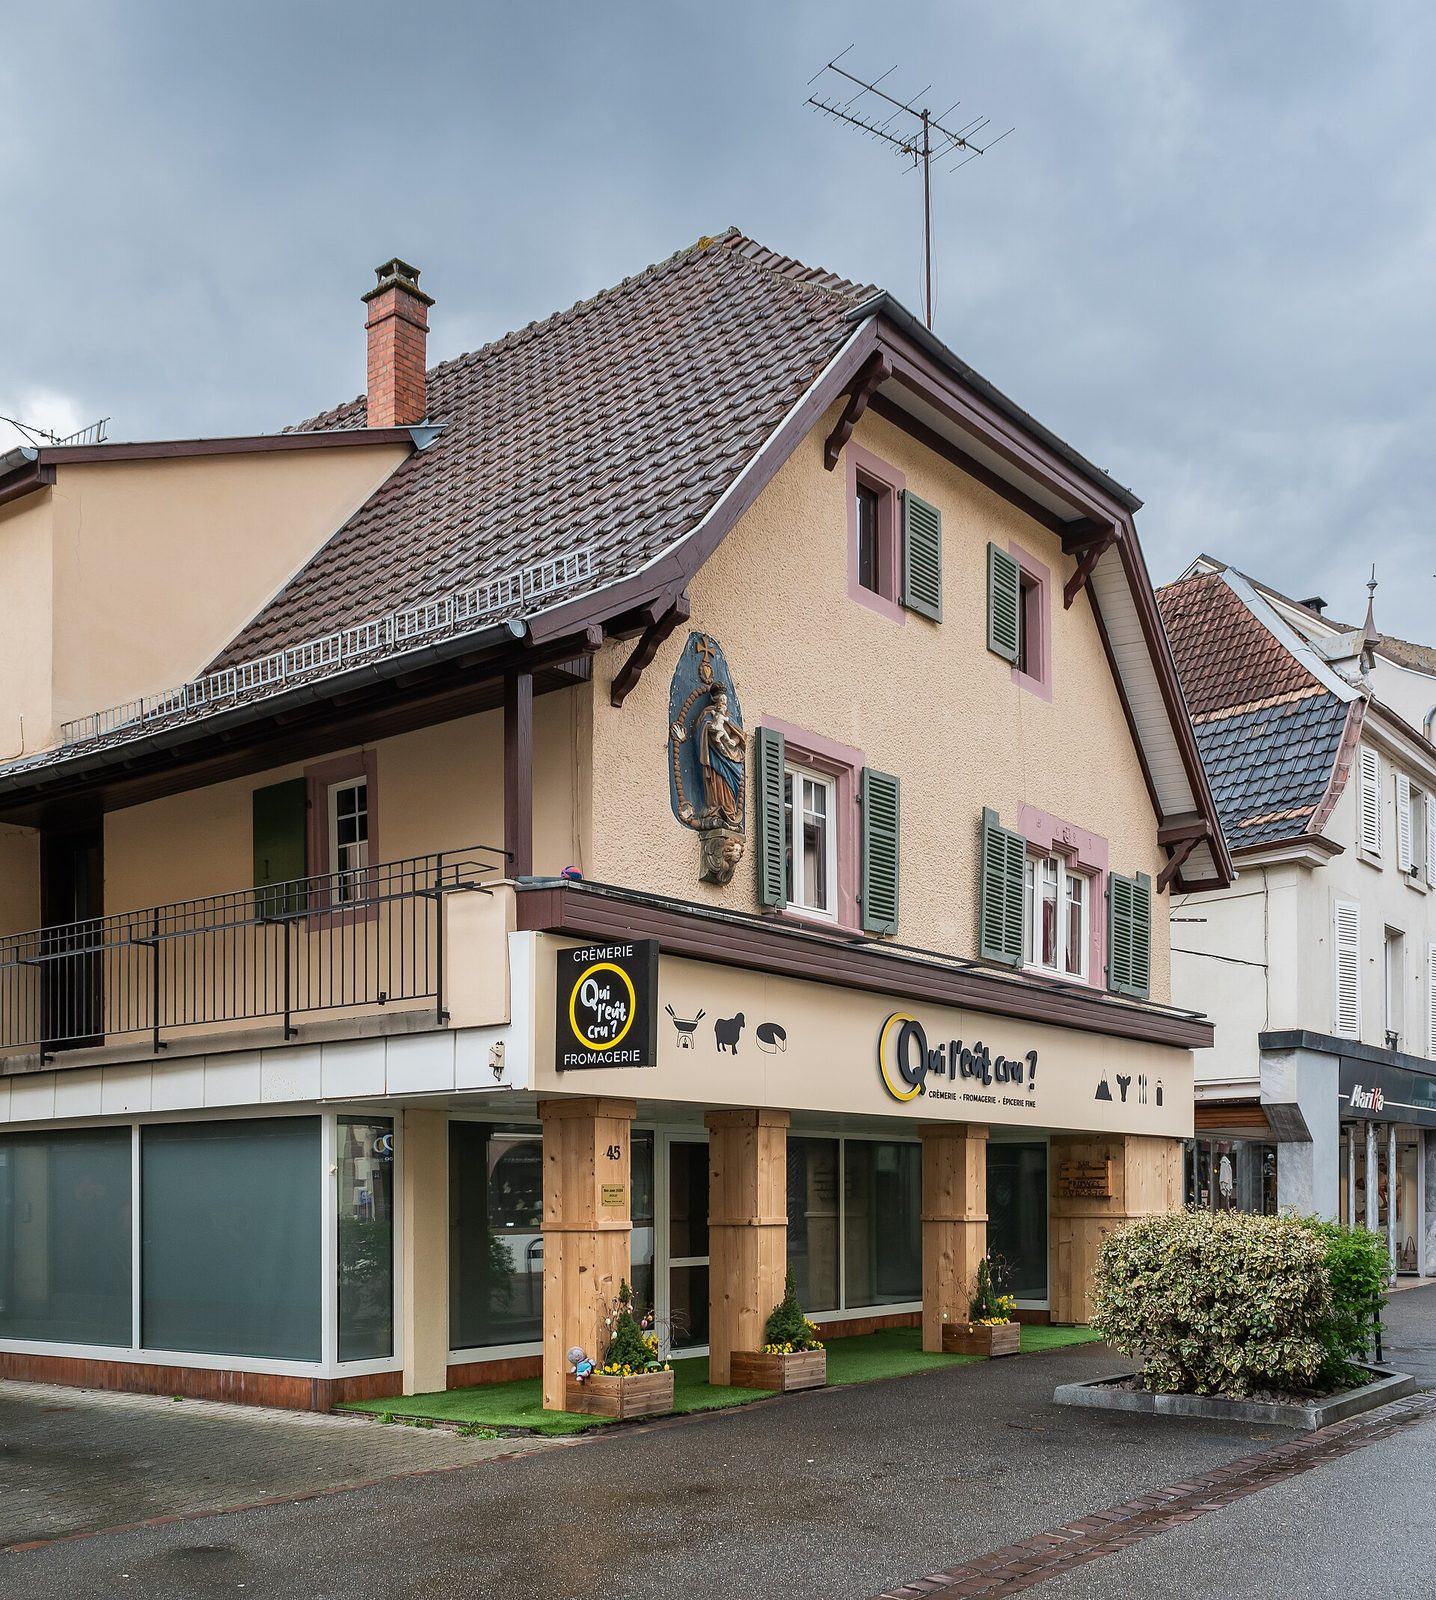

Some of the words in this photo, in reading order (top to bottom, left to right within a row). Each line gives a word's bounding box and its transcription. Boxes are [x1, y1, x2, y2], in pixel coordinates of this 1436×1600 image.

[573, 945, 633, 962] CRÈMERIE
[581, 979, 610, 1011] Qui
[597, 1001, 627, 1022] l'eût
[564, 1050, 641, 1065] FROMAGERIE
[898, 1020, 946, 1096] Qui
[950, 1039, 992, 1086] l'eût
[928, 1089, 957, 1101] CRÈMERIE
[963, 1094, 997, 1104] FROMAGERIE
[1002, 1096, 1024, 1107] ÉPICERIE
[1025, 1100, 1036, 1108] FINE
[606, 1145, 621, 1160] 45
